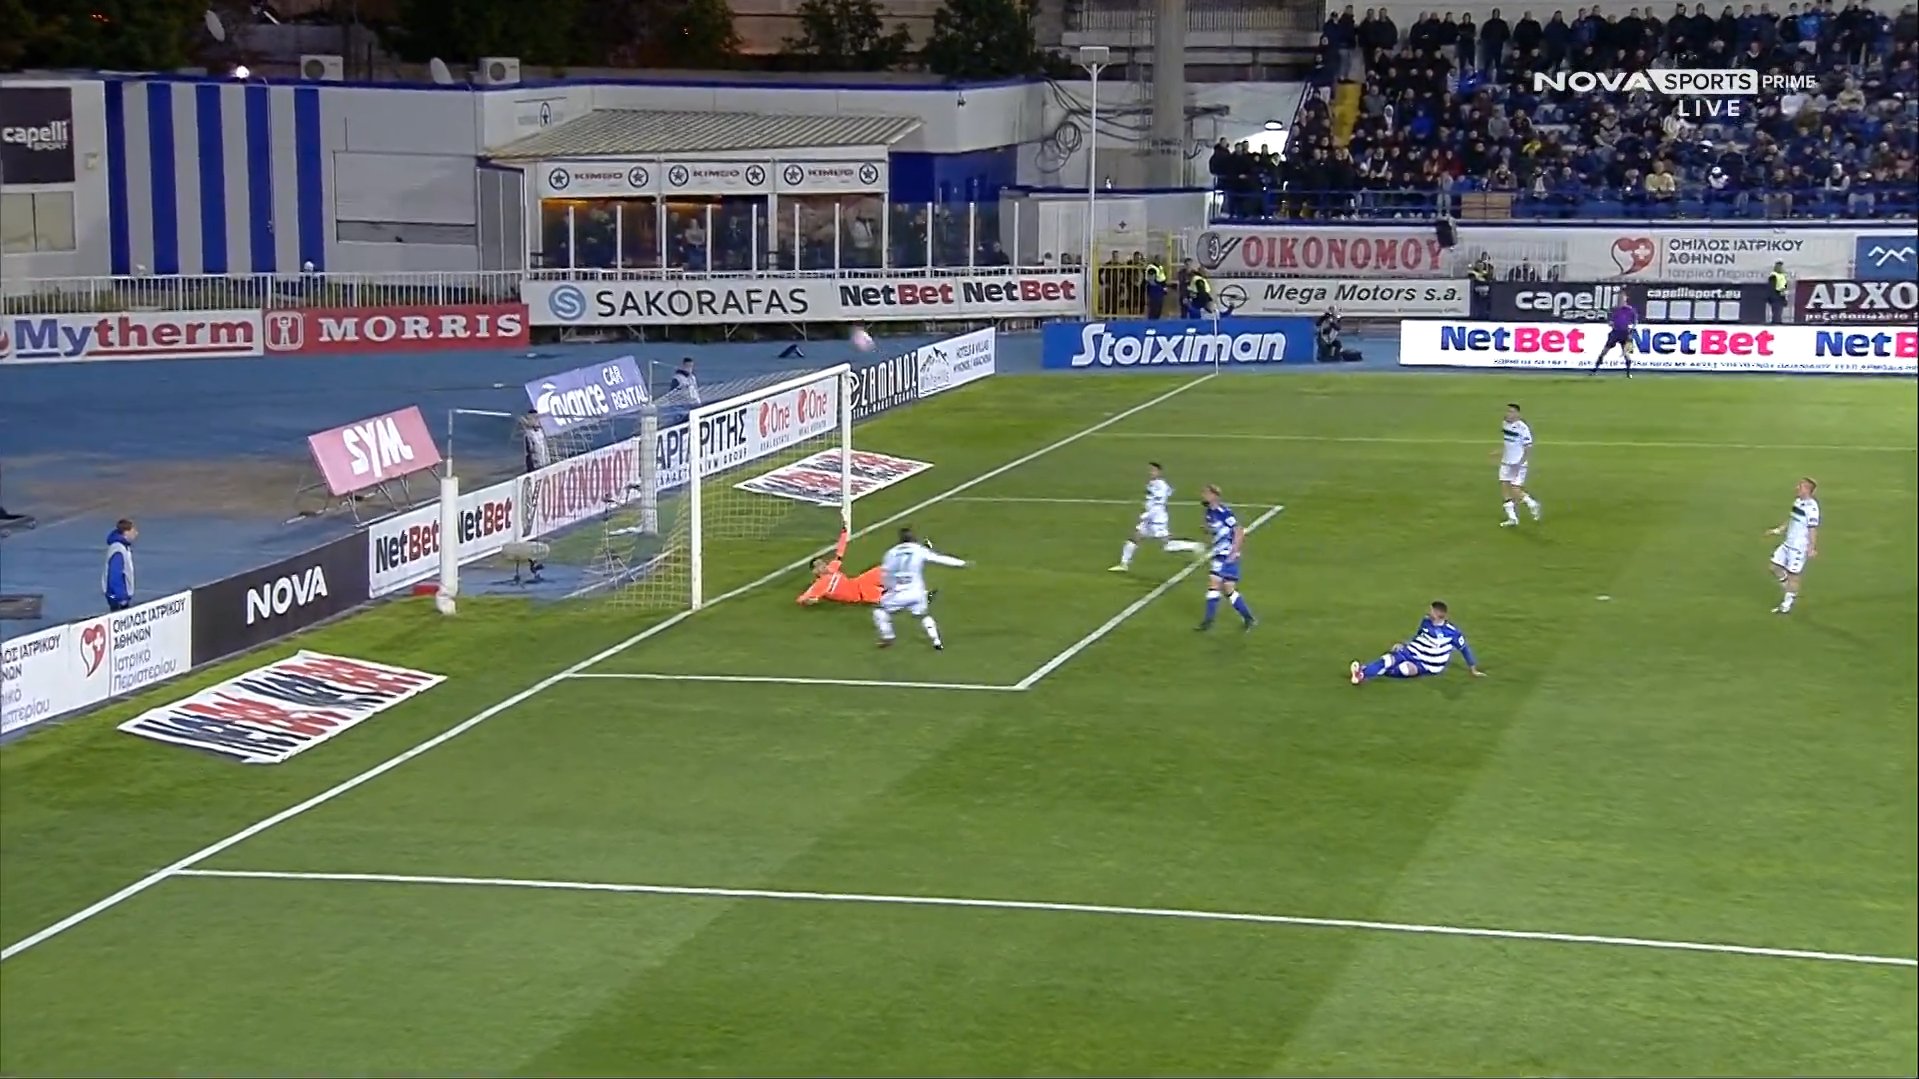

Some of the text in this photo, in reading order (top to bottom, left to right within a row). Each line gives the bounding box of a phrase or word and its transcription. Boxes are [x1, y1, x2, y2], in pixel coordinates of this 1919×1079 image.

[2, 121, 67, 149] capelli
[596, 288, 808, 317] SAKORAFAS
[839, 279, 1077, 306] NetBet NetBet
[1264, 284, 1463, 304] Mega Motors s.a.
[1515, 285, 1619, 316] capelli
[1647, 287, 1742, 300] capellisport.eu
[14, 316, 254, 357] Mytherm
[318, 313, 522, 342] MORRIS
[1441, 326, 1585, 353] NetBet
[1071, 323, 1287, 367] Stoiximan
[602, 365, 624, 386] CAR
[611, 384, 649, 411] RENTAL
[808, 389, 828, 419] One
[771, 402, 790, 433] One
[342, 417, 414, 478] SYM
[375, 519, 440, 574] NetBet
[246, 565, 328, 625] NOVA
